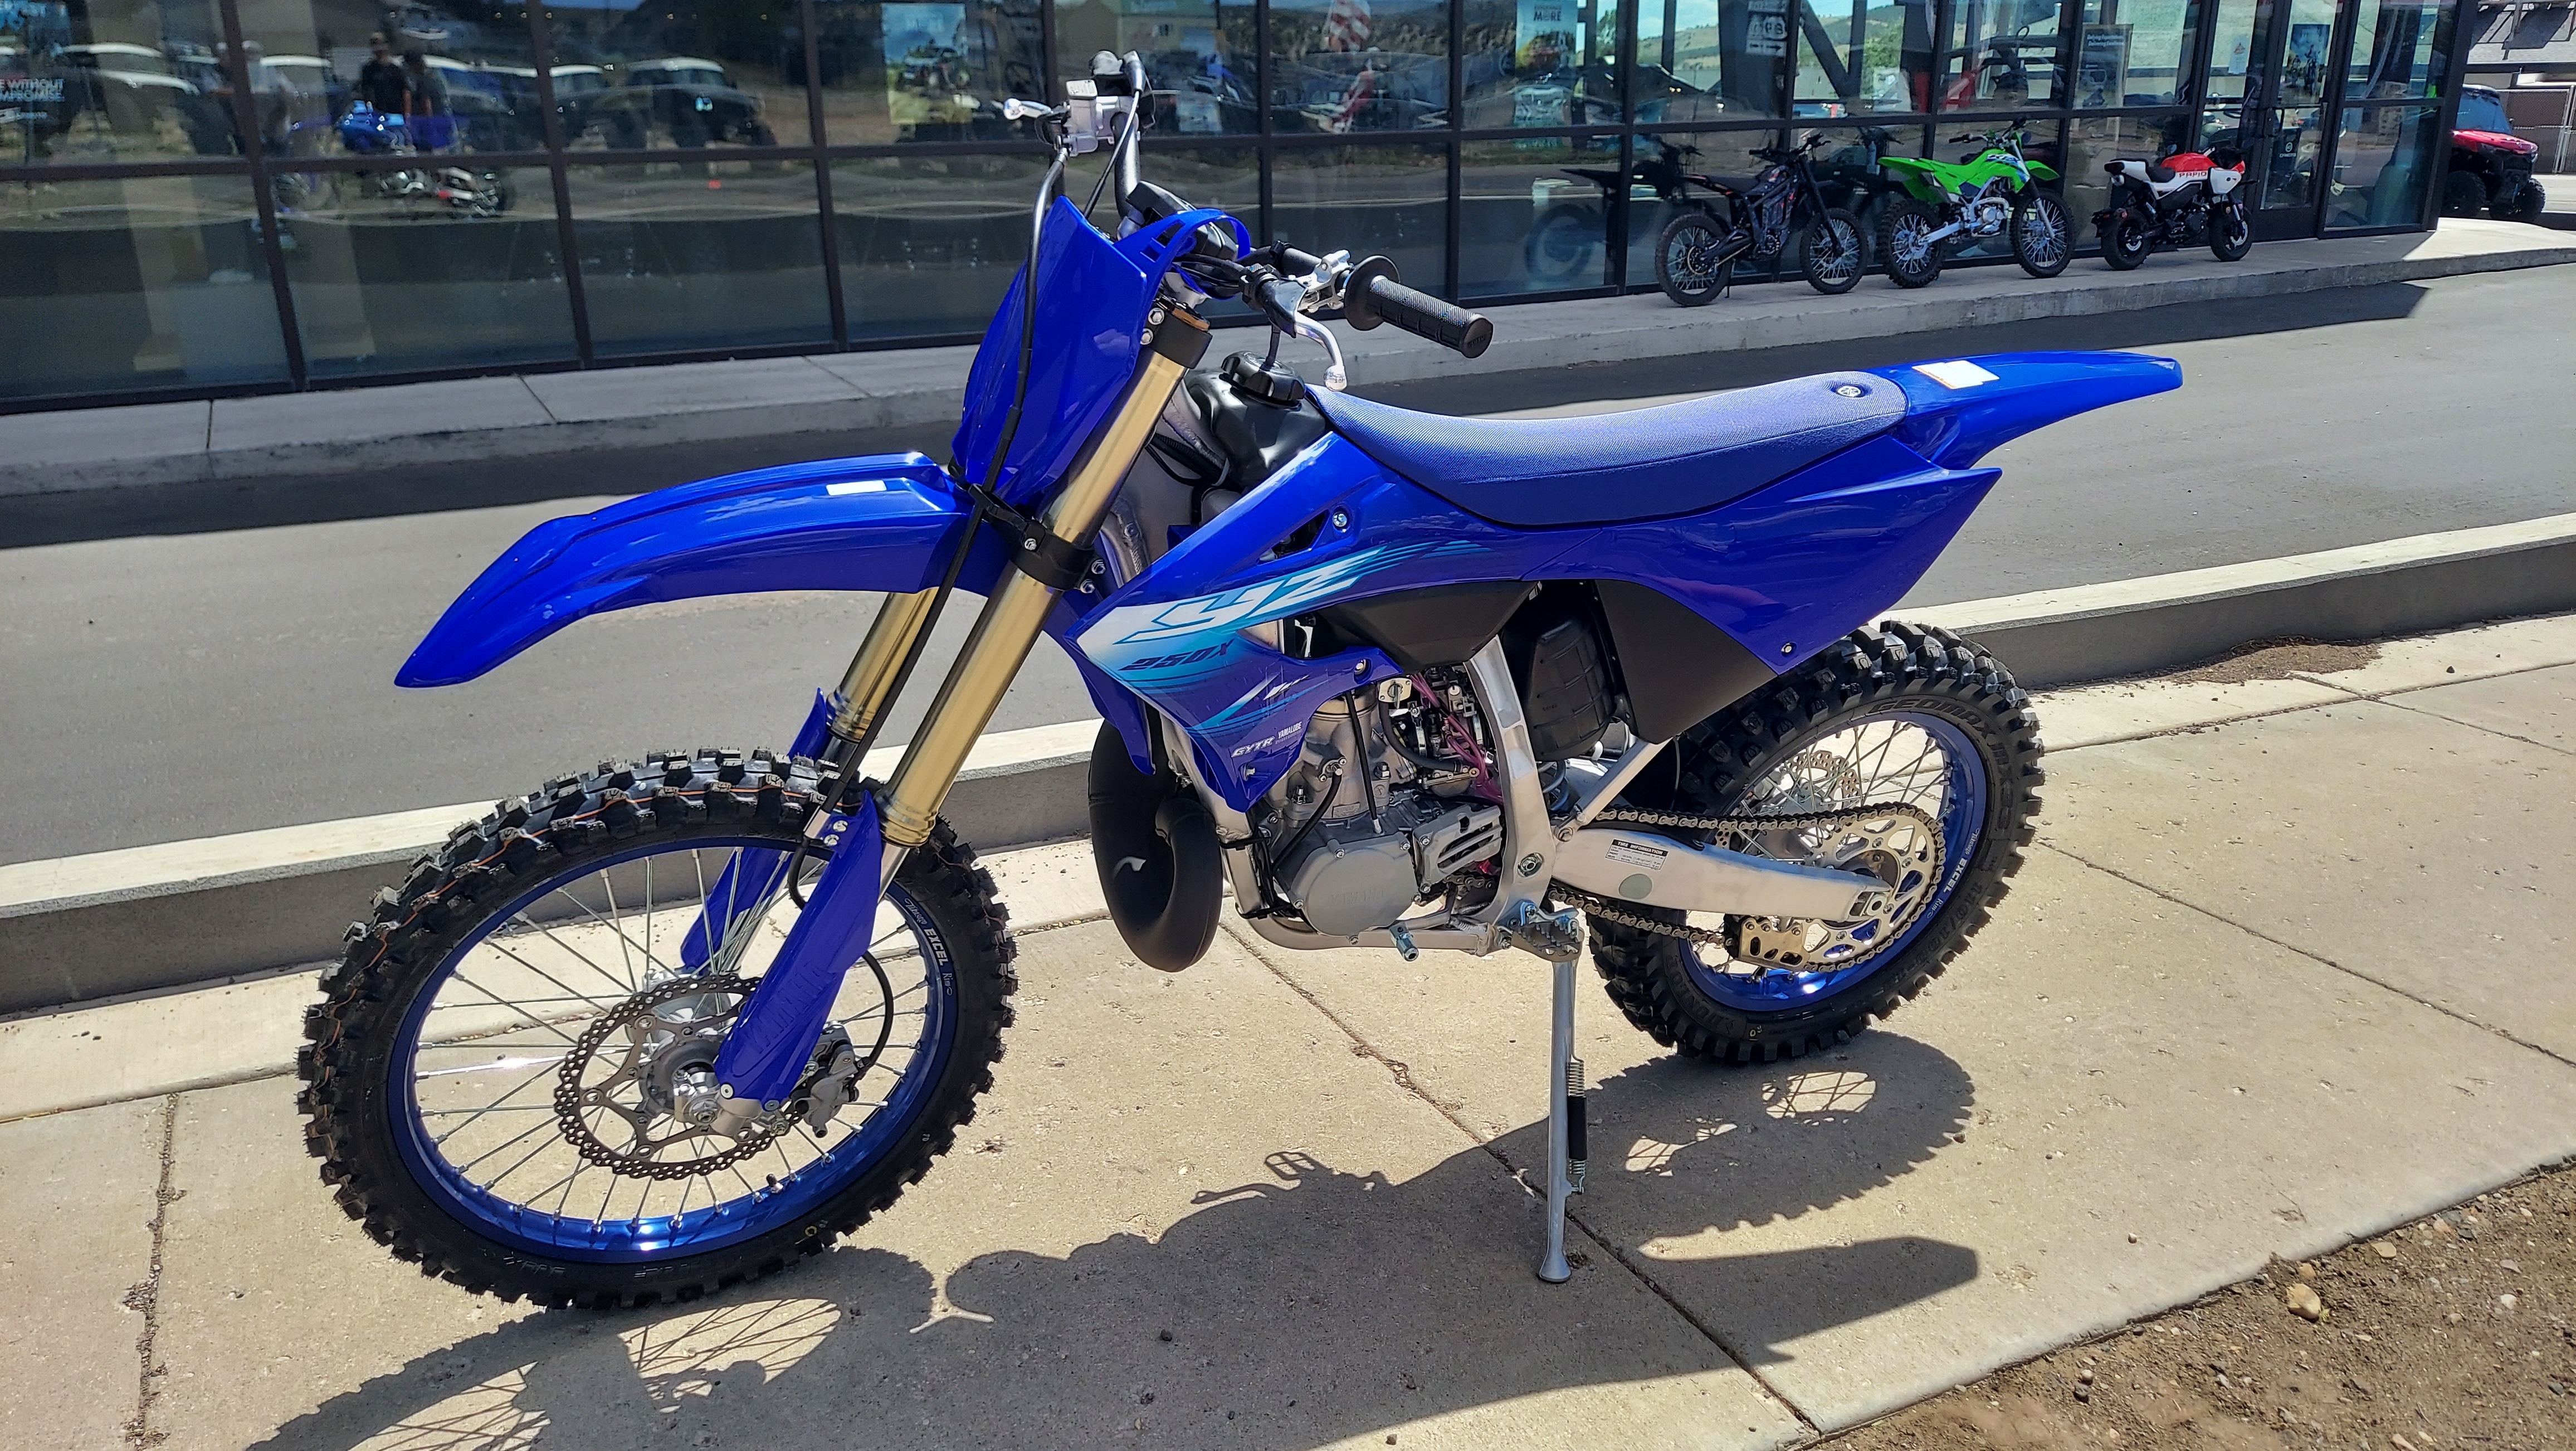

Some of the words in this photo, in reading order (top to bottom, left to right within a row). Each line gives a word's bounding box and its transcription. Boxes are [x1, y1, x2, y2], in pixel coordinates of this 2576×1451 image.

[1112, 545, 1388, 645] YZ
[1118, 637, 1236, 671] 250X
[1278, 721, 1302, 739] YAMALUBE
[1867, 698, 1996, 739] GEOMAX
[1231, 736, 1276, 758] GYTR
[1630, 844, 1663, 855] INFORMATION
[1943, 856, 1969, 895] EXCEL
[923, 928, 949, 966] EXCEL
